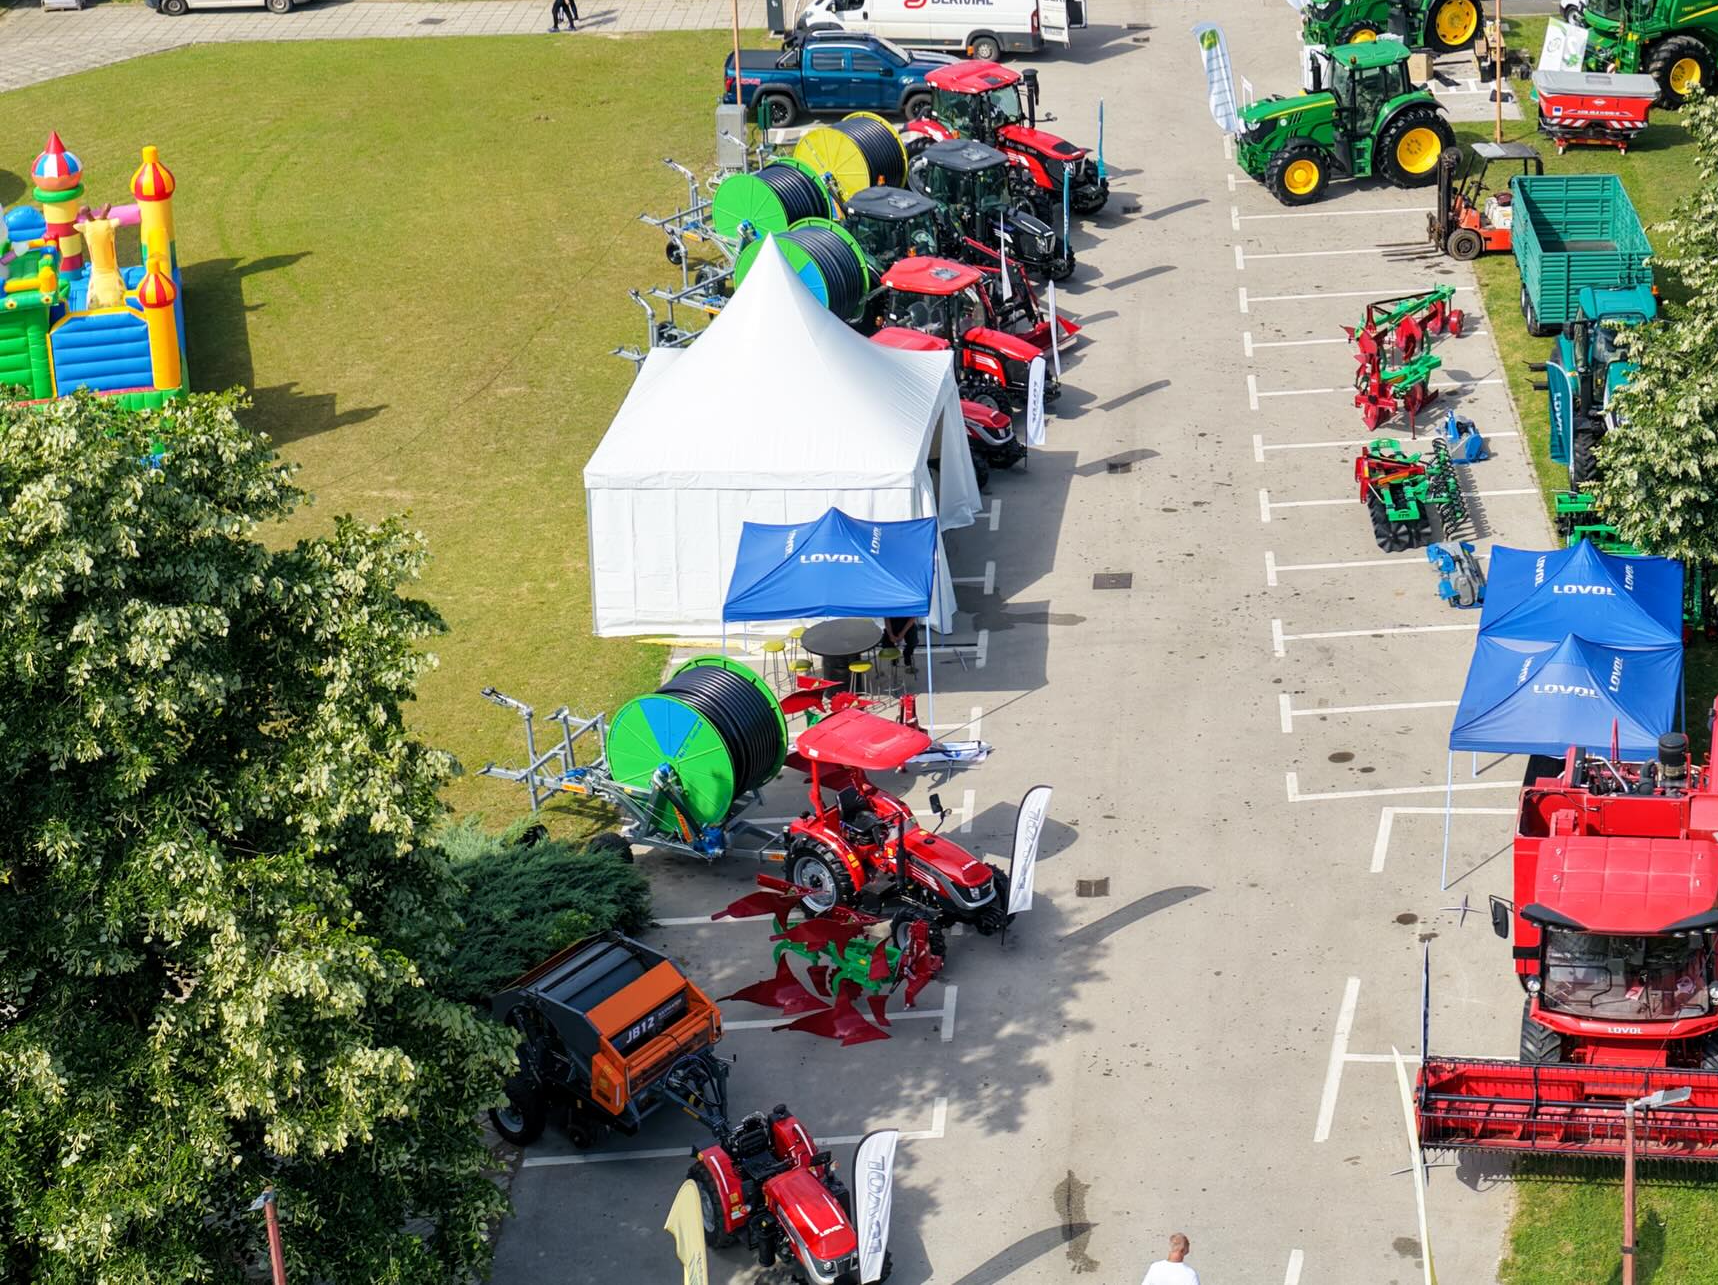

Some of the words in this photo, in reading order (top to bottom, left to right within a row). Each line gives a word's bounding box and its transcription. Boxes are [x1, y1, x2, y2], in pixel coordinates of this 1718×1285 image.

[800, 553, 864, 564] LOVOL
[1553, 584, 1617, 596] LOVOL
[1608, 656, 1624, 693] LOVOL
[1532, 683, 1601, 699] LOVOL
[626, 1016, 655, 1044] JB12
[1607, 1026, 1644, 1034] LOVOL
